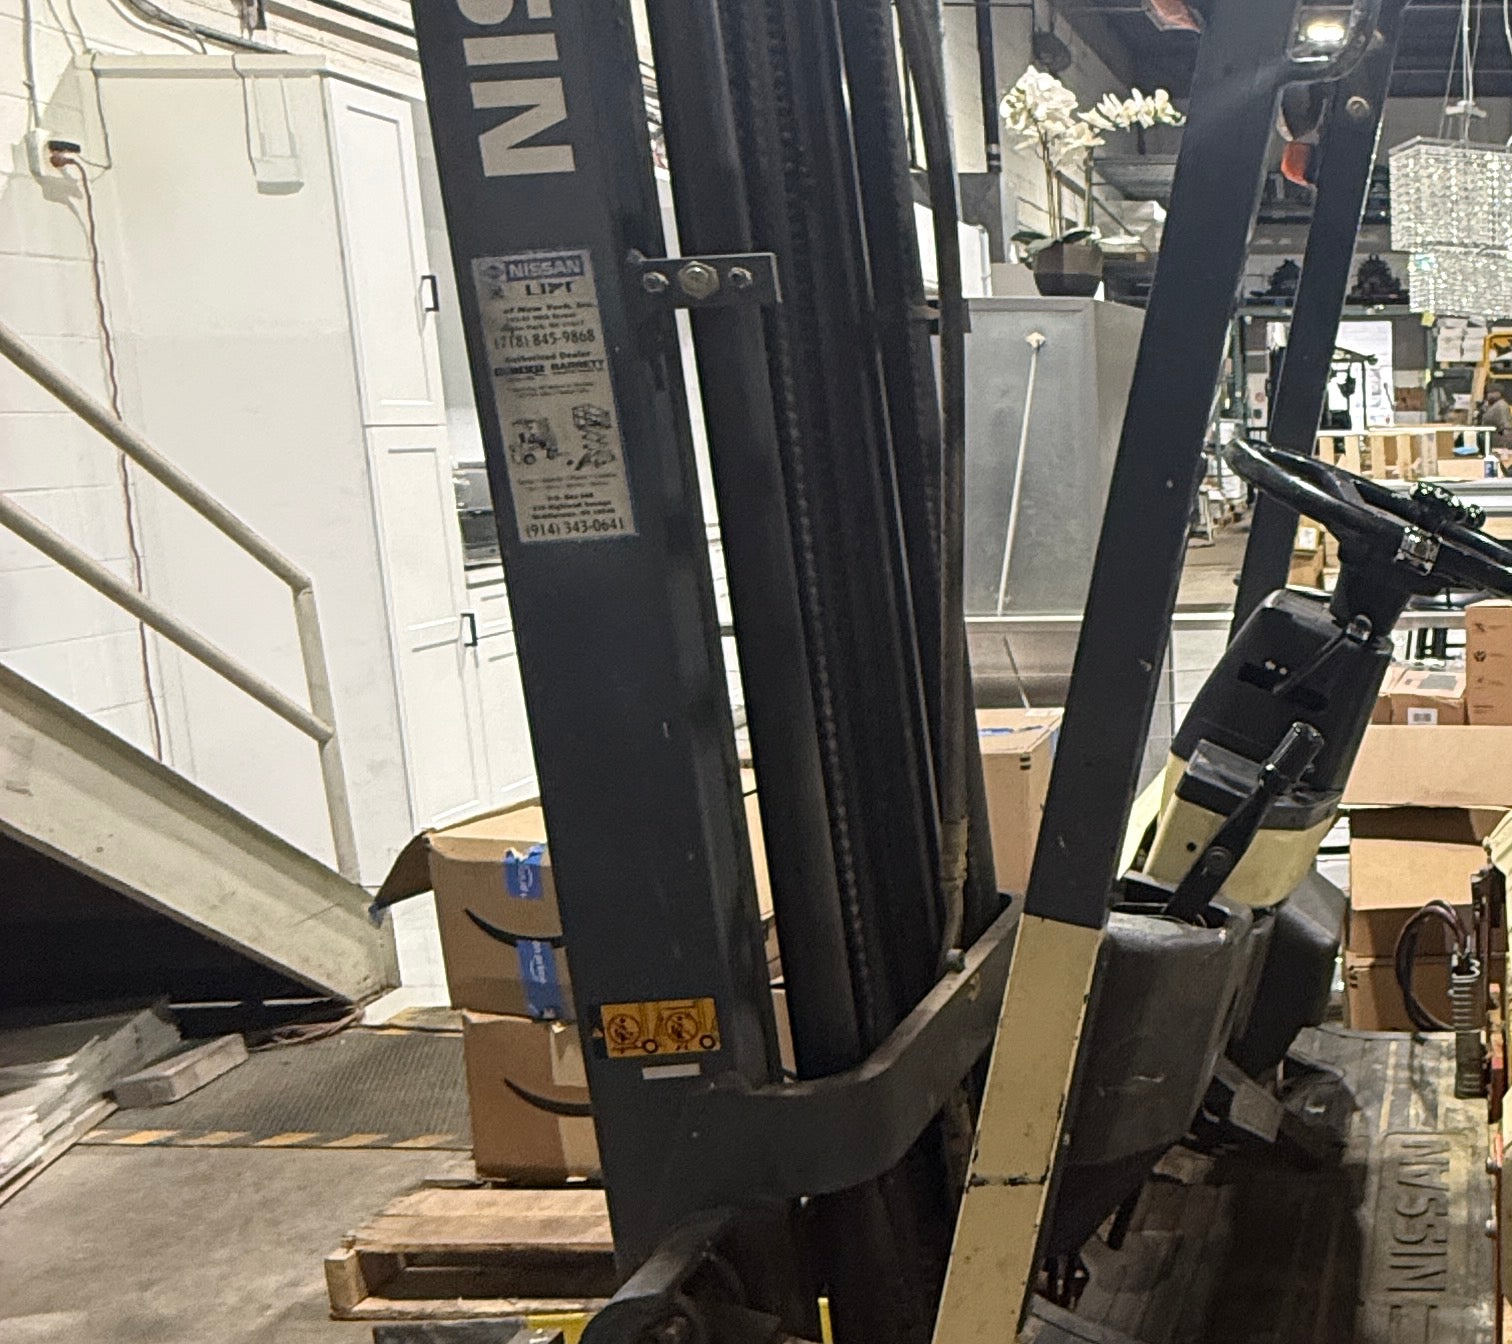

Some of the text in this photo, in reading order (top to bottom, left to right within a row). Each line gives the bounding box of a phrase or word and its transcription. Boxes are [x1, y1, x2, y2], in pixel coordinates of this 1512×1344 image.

[508, 258, 581, 278] NISSAN
[532, 328, 596, 346] 845-9868
[525, 517, 625, 538] (914) 343-0641
[1386, 1140, 1450, 1293] NISSAN
